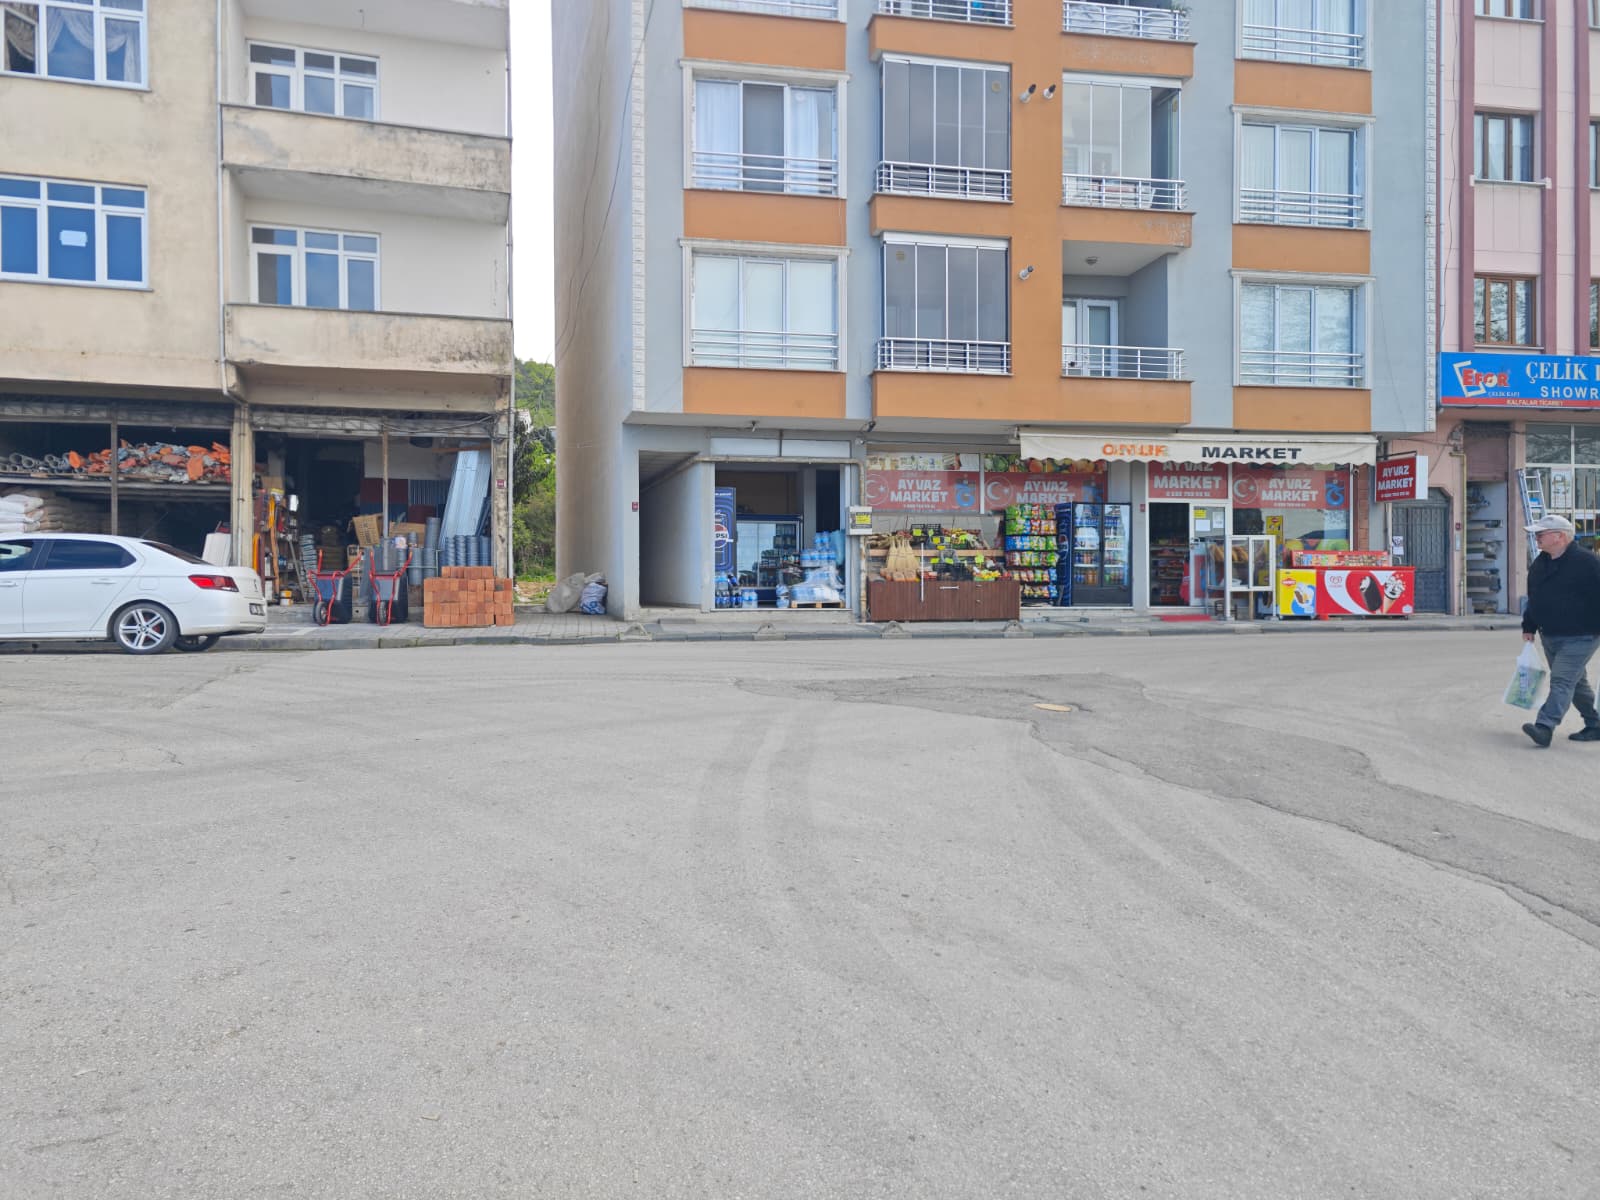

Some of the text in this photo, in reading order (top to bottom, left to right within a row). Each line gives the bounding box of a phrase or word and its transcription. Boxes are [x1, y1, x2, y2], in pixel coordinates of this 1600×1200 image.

[1525, 357, 1589, 384] ÇELİK
[1201, 446, 1302, 460] MARKET
[1162, 461, 1214, 472] AYVAZ
[1383, 465, 1410, 478] AYVAZ
[897, 479, 943, 491] AYVAZ
[1023, 481, 1069, 492] AYVAZ
[1153, 475, 1223, 489] MARKET
[1269, 478, 1313, 490] AYVAZ
[1378, 477, 1414, 490] MARKET
[890, 491, 949, 503] MARKET
[1016, 493, 1076, 504] MARKET
[1261, 490, 1319, 502] MARKET
